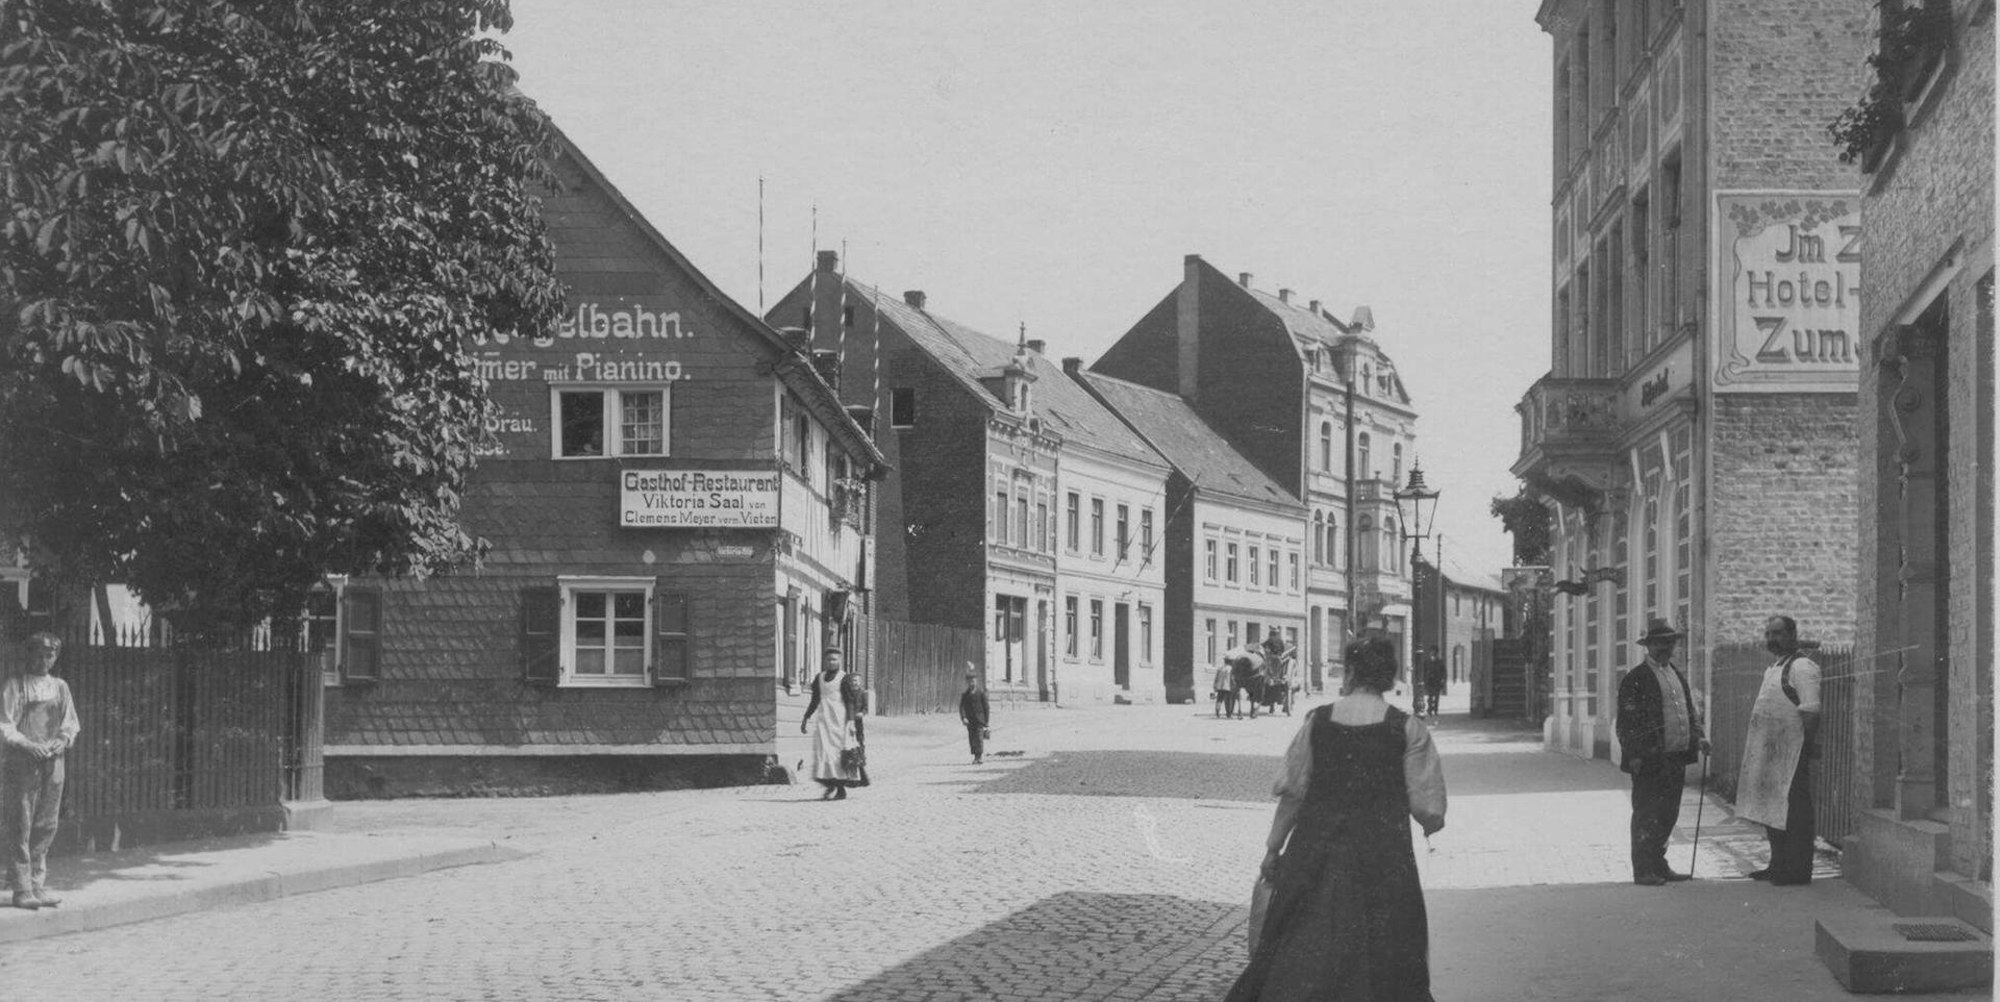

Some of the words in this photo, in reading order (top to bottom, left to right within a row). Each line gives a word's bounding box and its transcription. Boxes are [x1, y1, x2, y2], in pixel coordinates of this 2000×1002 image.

[1746, 270, 1860, 308] Hotel-
[471, 303, 694, 348] elbahn.
[1752, 316, 1853, 363] Zum
[543, 363, 569, 381] mit
[575, 352, 692, 381] Pianino.
[624, 472, 779, 492] Gasthof-Restaurant
[643, 493, 705, 509] Viktoria
[709, 493, 744, 509] Saal
[625, 510, 677, 524] Clemens
[679, 511, 716, 525] Meyer
[740, 511, 777, 524] Vieten
